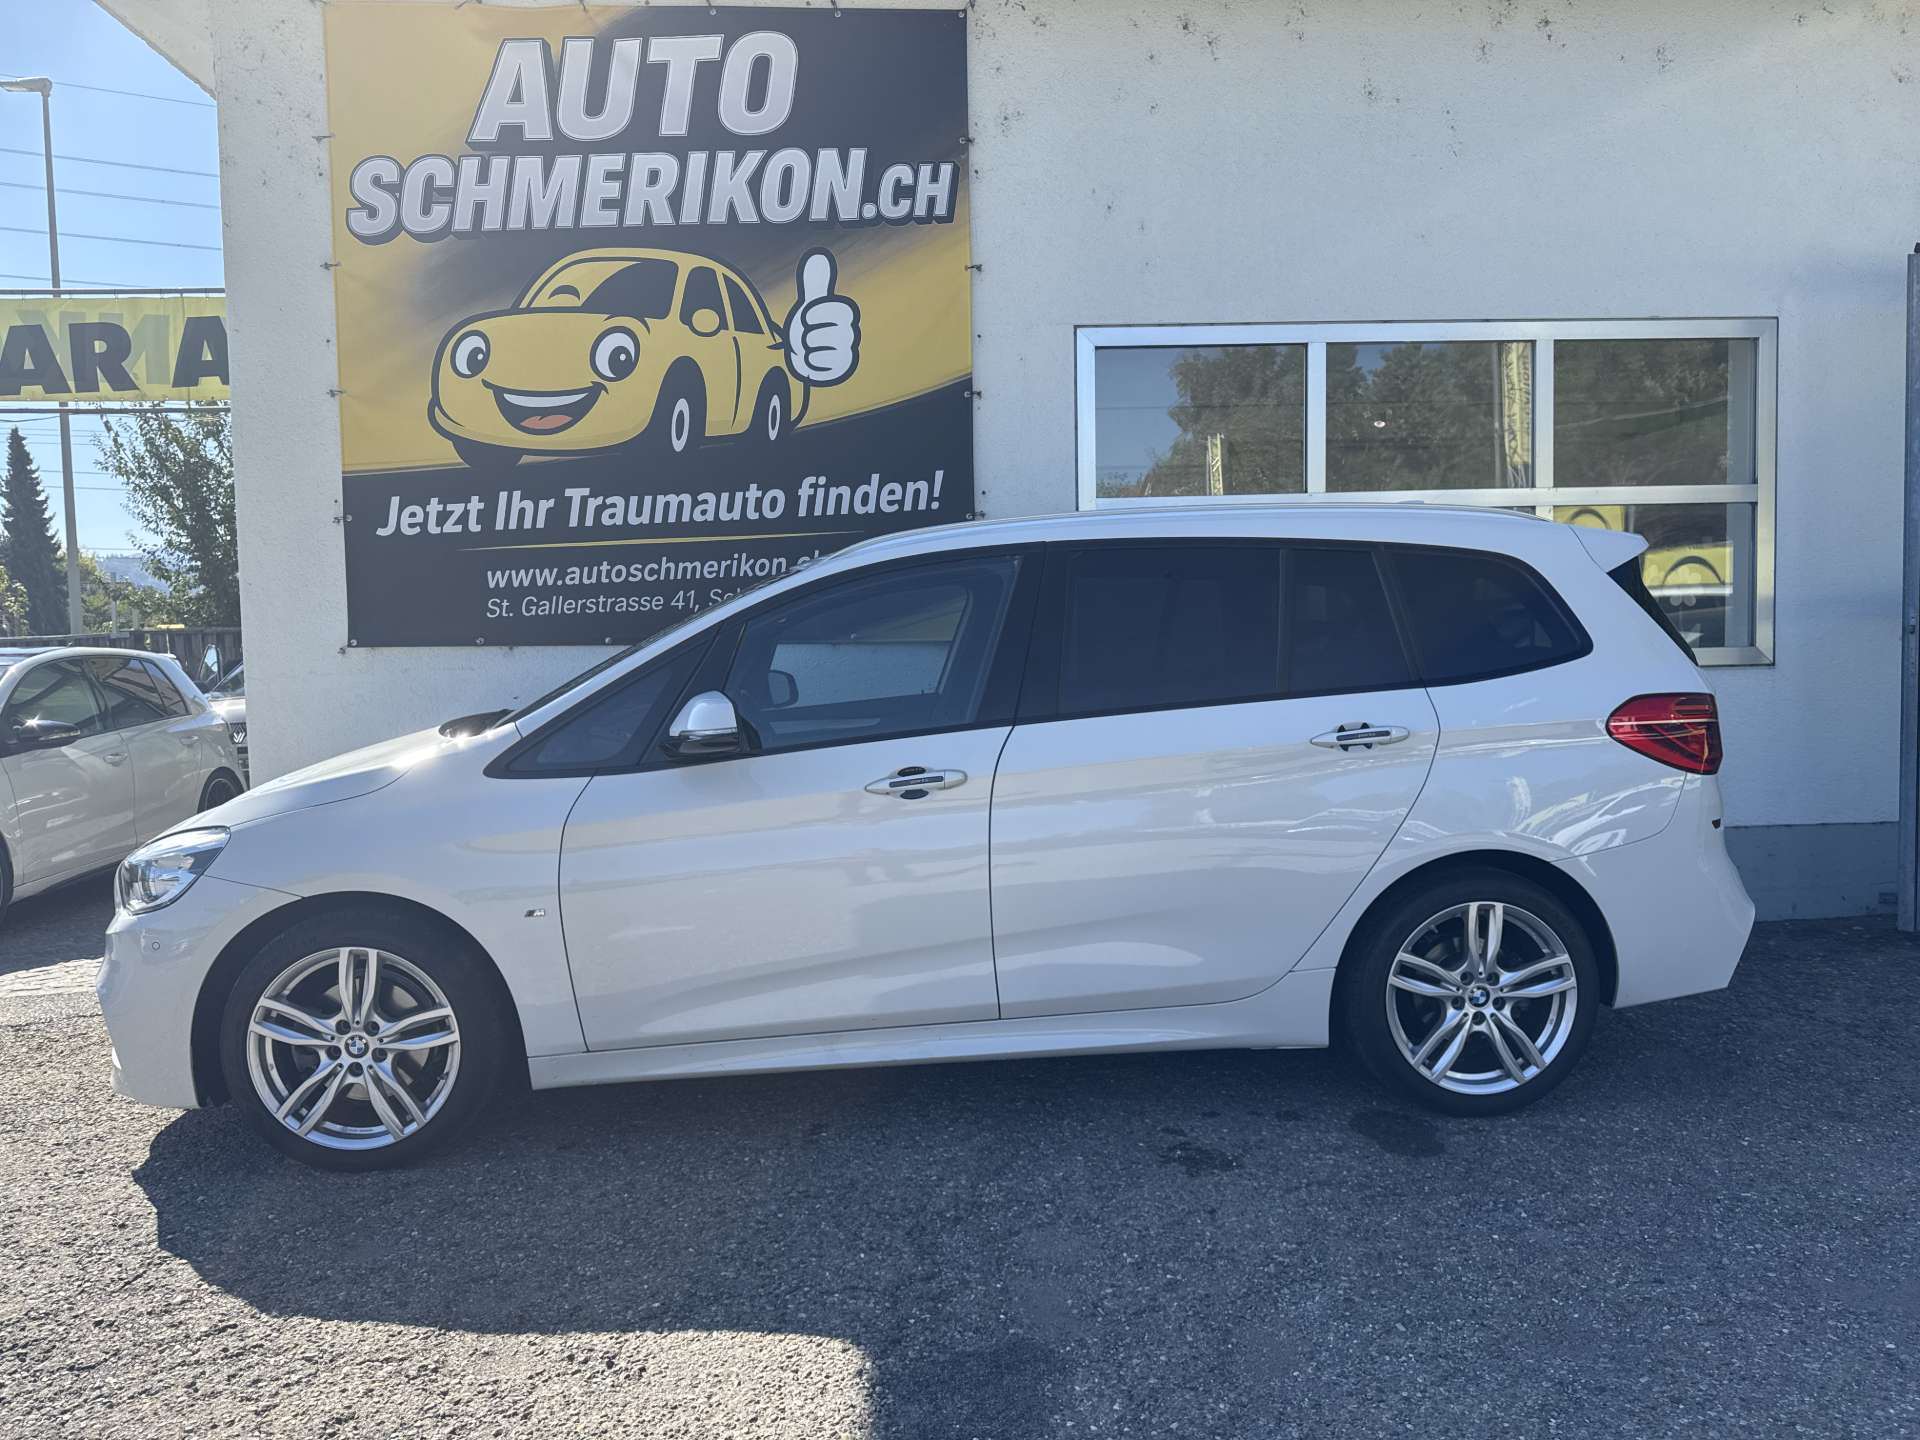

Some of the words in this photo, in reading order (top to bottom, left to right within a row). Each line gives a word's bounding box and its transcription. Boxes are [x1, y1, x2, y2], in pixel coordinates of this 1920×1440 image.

[468, 31, 799, 143] AUTO
[347, 147, 955, 236] SCHMERIKON.CH
[376, 495, 485, 537] Jetzt
[495, 490, 555, 531] Ihr
[564, 483, 786, 528] Traumauto
[798, 470, 944, 517] finden!
[486, 598, 514, 618] St.
[521, 595, 664, 617] Gallerstrasse
[670, 589, 699, 613] 41,
